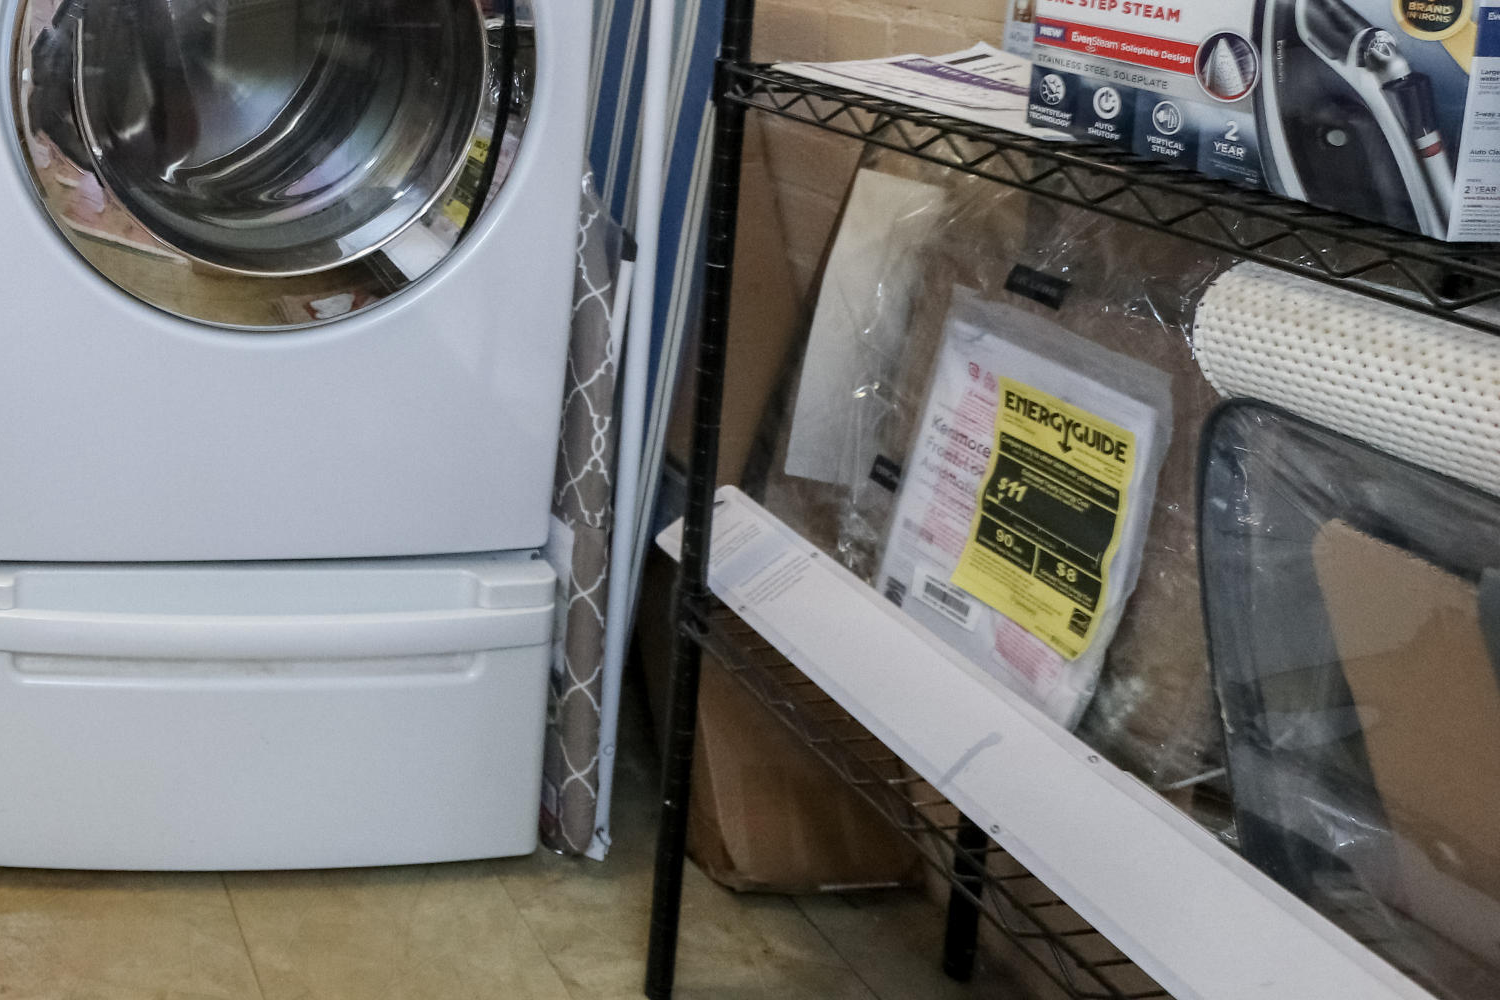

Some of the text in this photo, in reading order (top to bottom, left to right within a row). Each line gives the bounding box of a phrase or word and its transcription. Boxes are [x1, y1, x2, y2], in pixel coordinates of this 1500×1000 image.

[1123, 0, 1181, 22] STEAM
[1407, 11, 1452, 23] IN IRONS
[1408, 1, 1454, 15] BRAND
[1039, 25, 1192, 65] NEW EvenSteam Soleplate Design
[1038, 53, 1168, 90] STAINLESS STEEL SOLEPLATE
[1029, 111, 1070, 127] TECHNOLOGY
[1087, 127, 1120, 140] SHUTOFF
[1225, 120, 1238, 142] 2
[1146, 136, 1184, 151] VERTICAL
[1151, 145, 1179, 158] STEAM
[1213, 141, 1245, 158] YEAR
[1464, 185, 1498, 194] 2 YEAR
[931, 415, 991, 459] Kenmore
[1004, 390, 1128, 464] ENERGYGUIDE
[997, 476, 1029, 503] $11
[995, 528, 1015, 548] 90
[1056, 561, 1079, 583] $8
